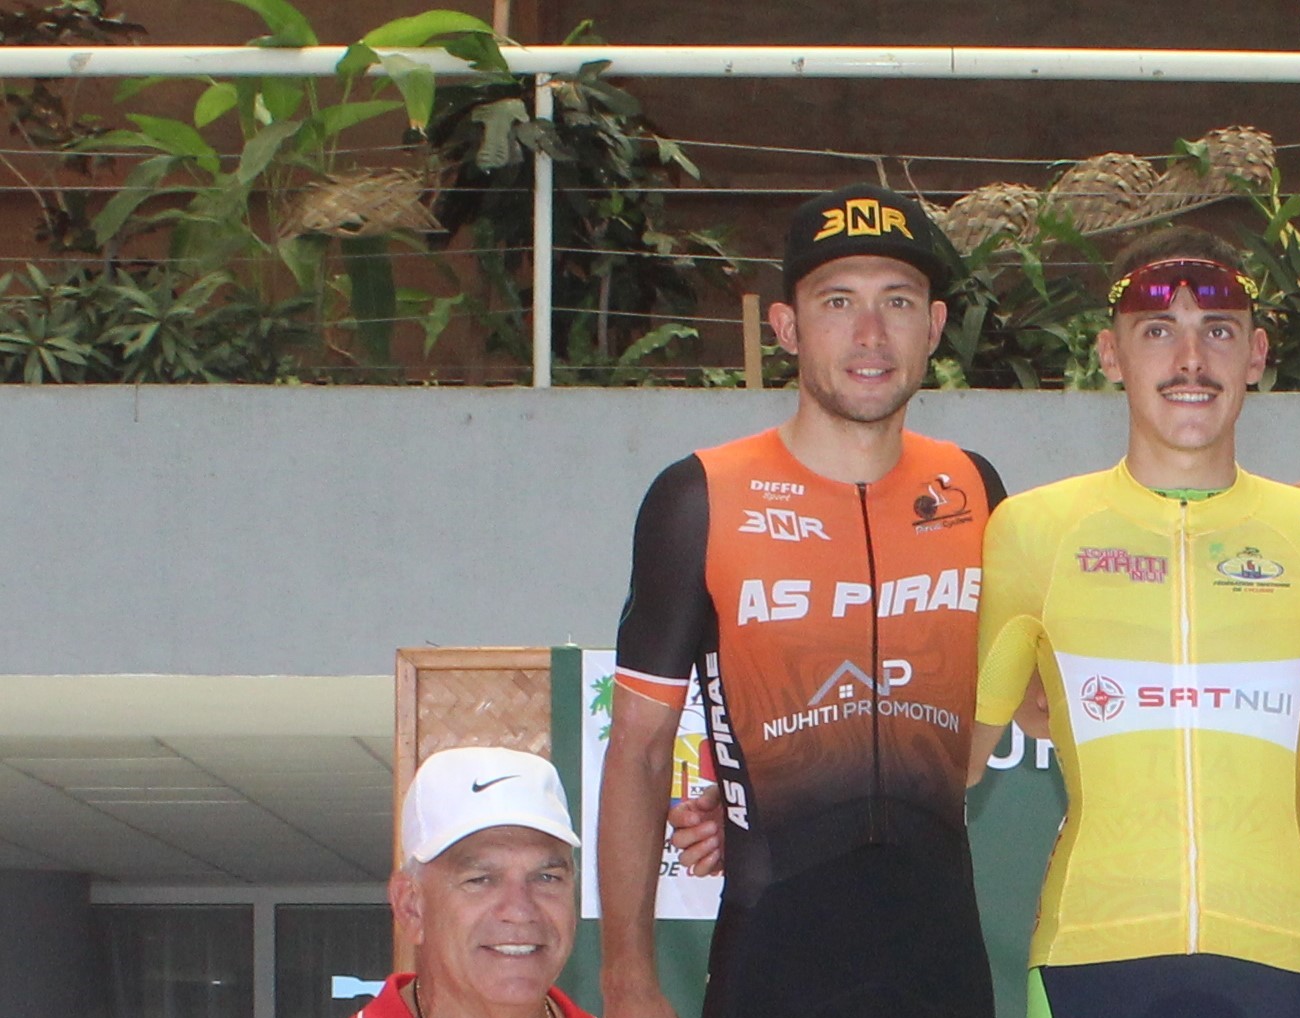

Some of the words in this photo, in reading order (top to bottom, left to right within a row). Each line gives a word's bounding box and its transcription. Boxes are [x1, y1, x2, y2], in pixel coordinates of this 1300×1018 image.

[751, 480, 804, 496] DIFFU
[1077, 553, 1168, 575] TAHITI
[738, 579, 811, 625] AS
[832, 567, 981, 617] PIRAE
[705, 652, 740, 769] PIRAE
[763, 704, 838, 741] NIUHITI
[727, 779, 750, 831] AS
